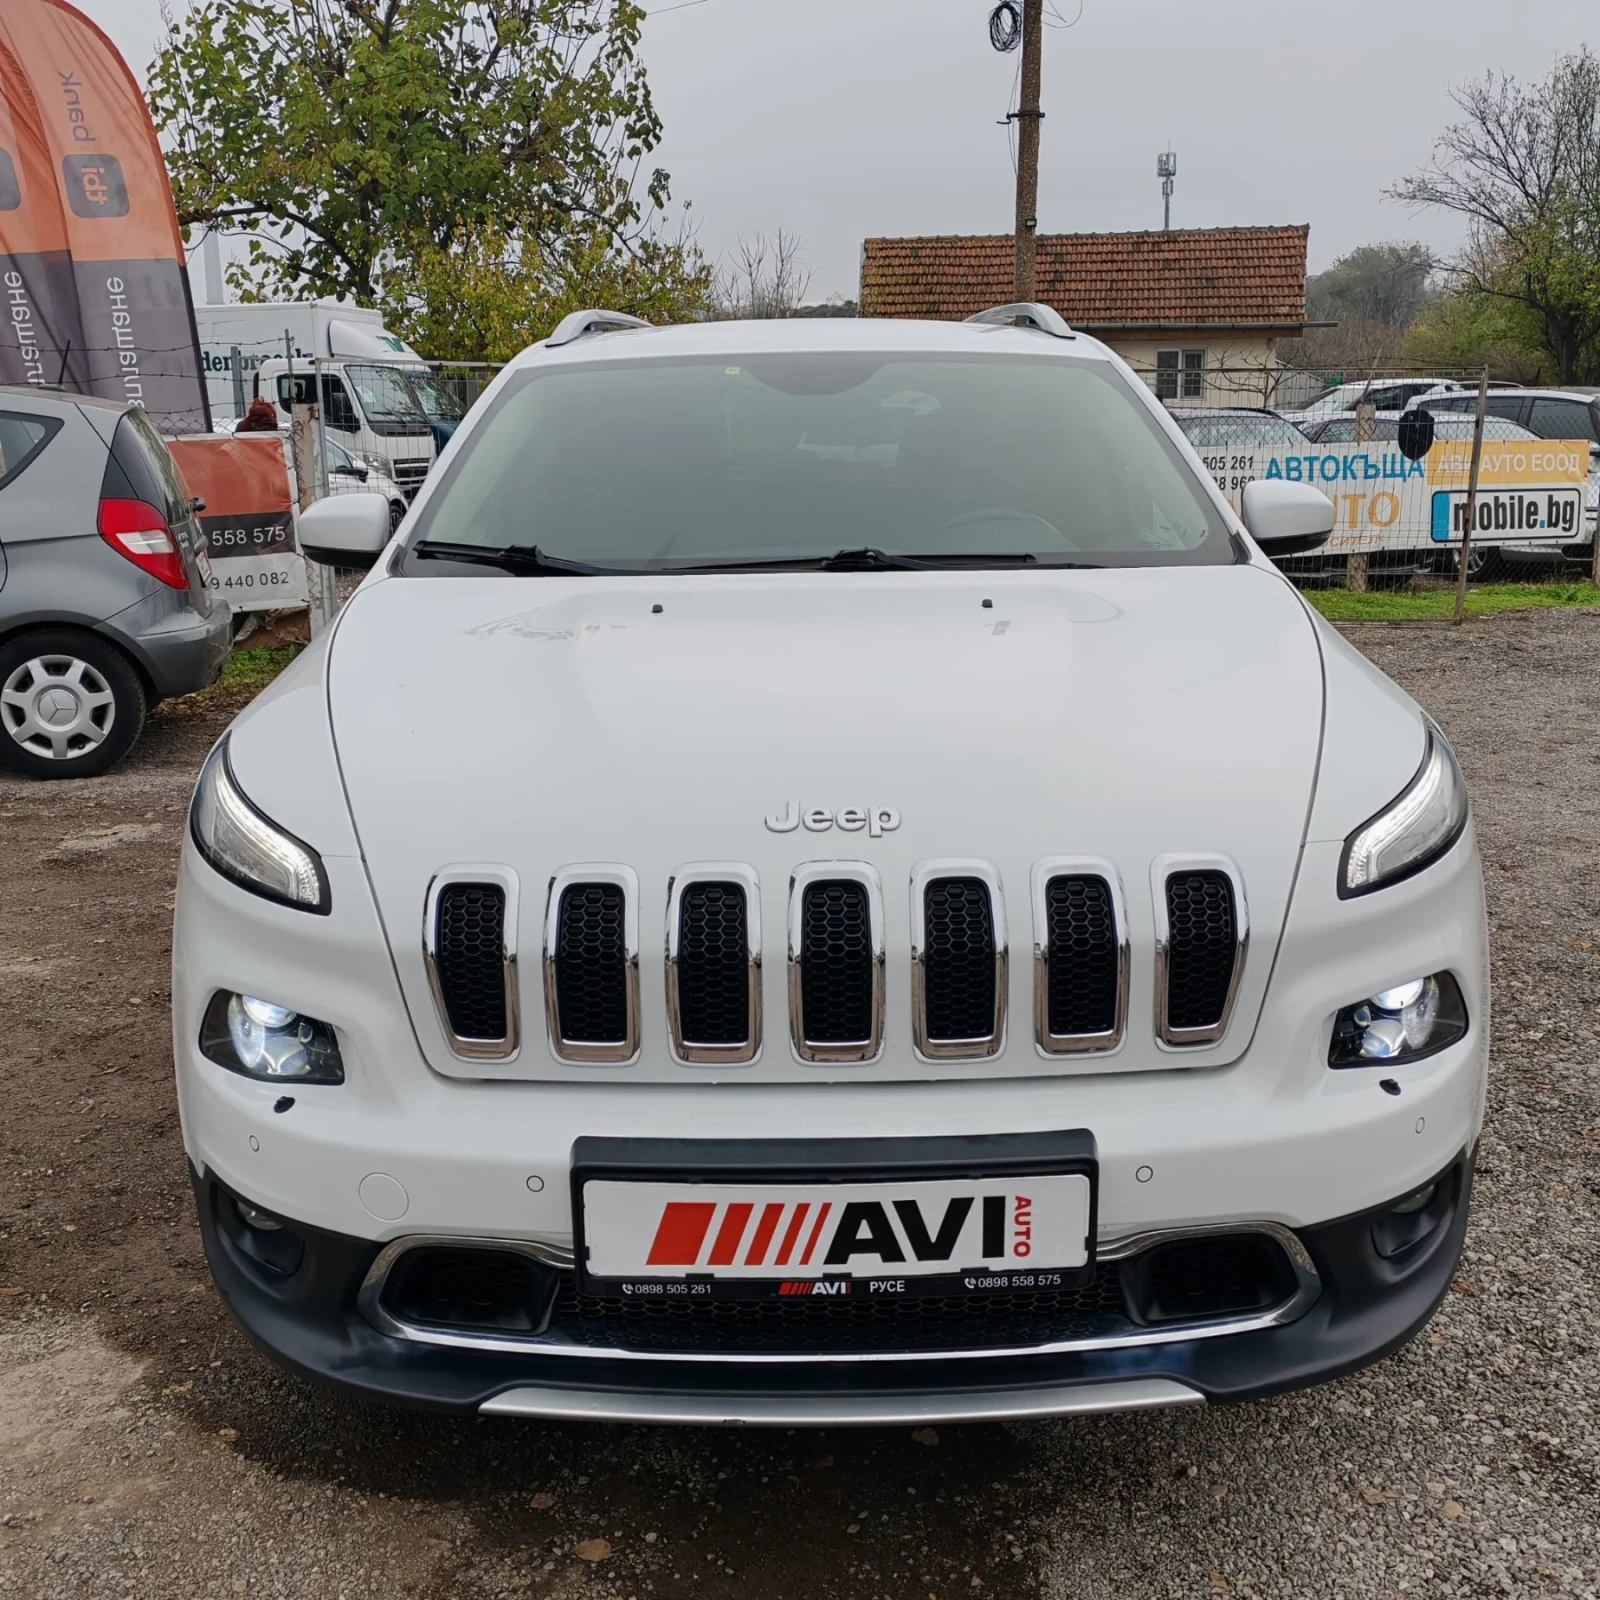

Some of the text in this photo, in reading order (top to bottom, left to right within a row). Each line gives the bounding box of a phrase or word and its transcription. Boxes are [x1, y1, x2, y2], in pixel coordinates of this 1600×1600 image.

[1230, 455, 1254, 470] 261
[1265, 453, 1424, 483] АВТОКЪЩА
[1481, 454, 1527, 473] АУТО
[1532, 453, 1580, 474] ЕООД
[1453, 494, 1575, 533] mobile.bg
[212, 526, 286, 546] 558 575
[224, 574, 254, 589] 440
[259, 571, 289, 586] 082
[764, 799, 902, 838] Jeep
[822, 1195, 1006, 1265] AVI
[1013, 1194, 1032, 1258] AUTO
[635, 1283, 711, 1294] 0898 505 261
[811, 1281, 846, 1295] AVI
[869, 1281, 905, 1293] РУСЕ
[978, 1274, 1061, 1288] 0898 558 575
